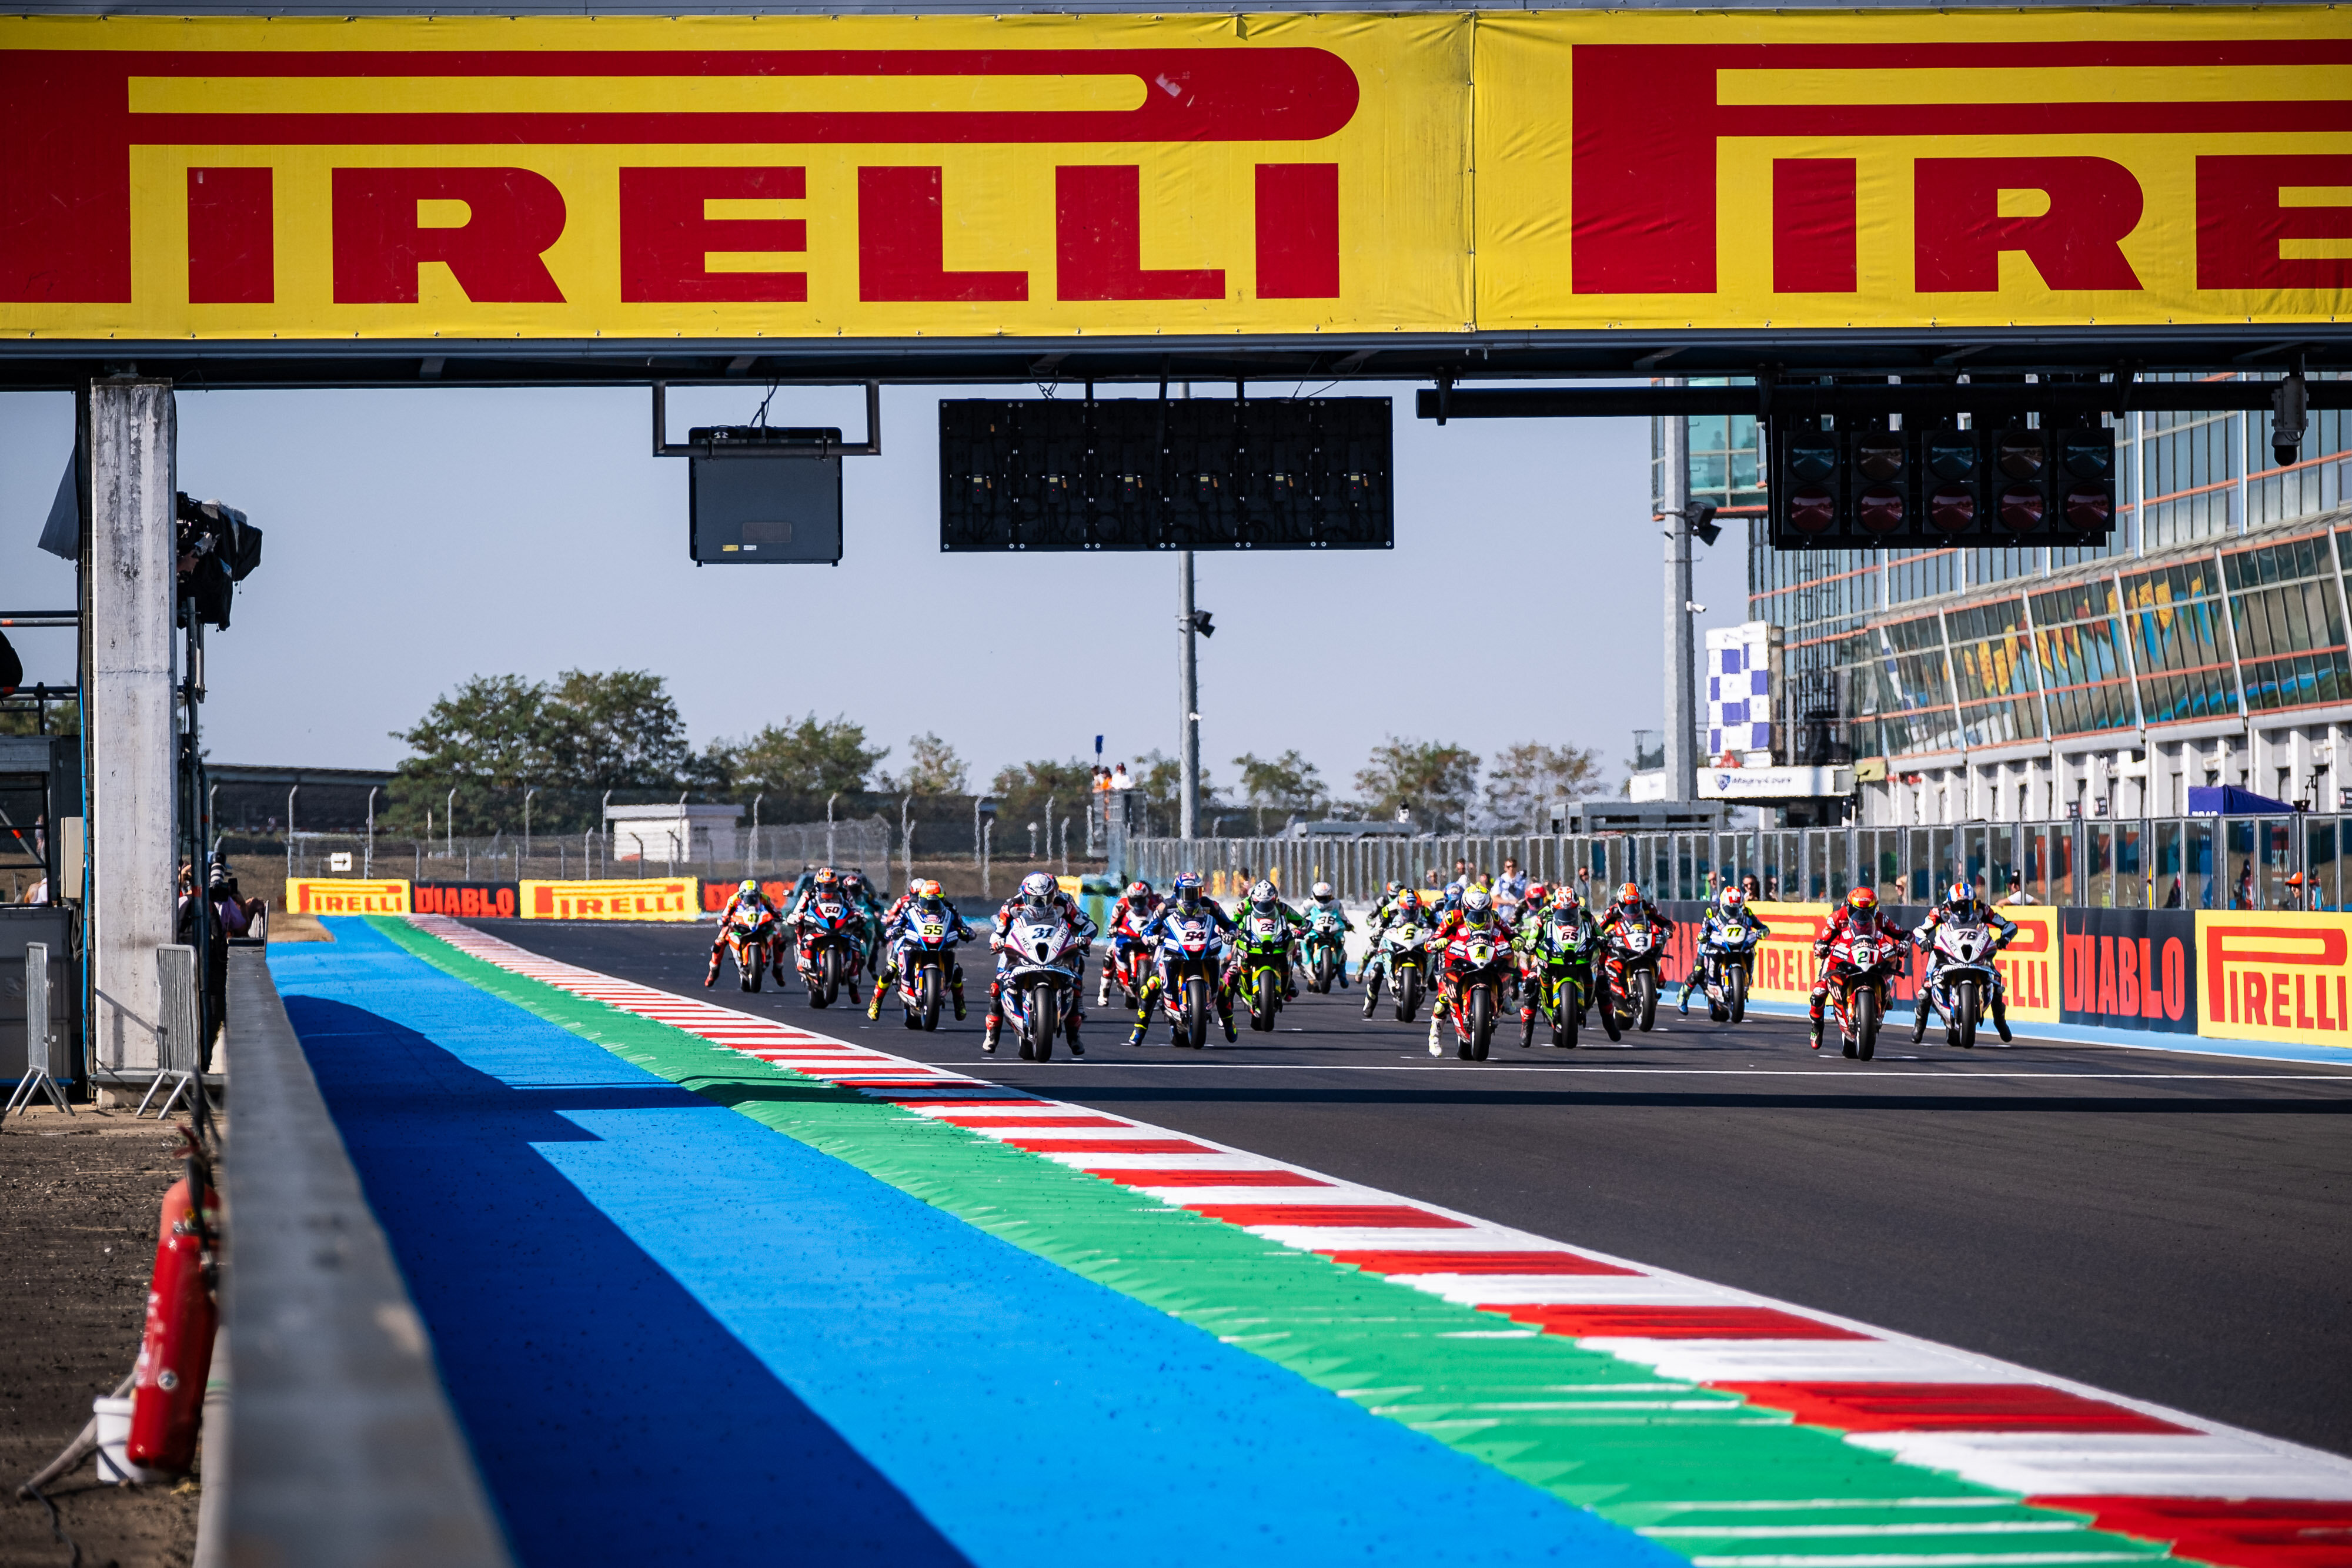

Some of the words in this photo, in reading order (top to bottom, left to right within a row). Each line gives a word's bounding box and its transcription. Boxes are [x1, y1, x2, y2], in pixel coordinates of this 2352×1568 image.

[0, 47, 1359, 303] PIRELLI
[299, 884, 402, 912] PIRELLI
[415, 883, 514, 918] DIABLO
[535, 884, 685, 915] PIRELLI
[1260, 923, 1275, 932] 22
[1318, 916, 1335, 926] 38
[924, 925, 943, 935] 55
[1032, 927, 1054, 940] 31
[1184, 931, 1206, 942] 54
[1404, 928, 1415, 941] 5
[1562, 931, 1579, 941] 65
[1726, 927, 1742, 937] 77
[1959, 931, 1978, 941] 76
[1475, 945, 1488, 959] 1
[1749, 913, 1828, 992] PIRELL
[1857, 951, 1876, 965] 21
[2063, 911, 2185, 1021] DIABLO
[2207, 926, 2348, 1031] PIRELLI
